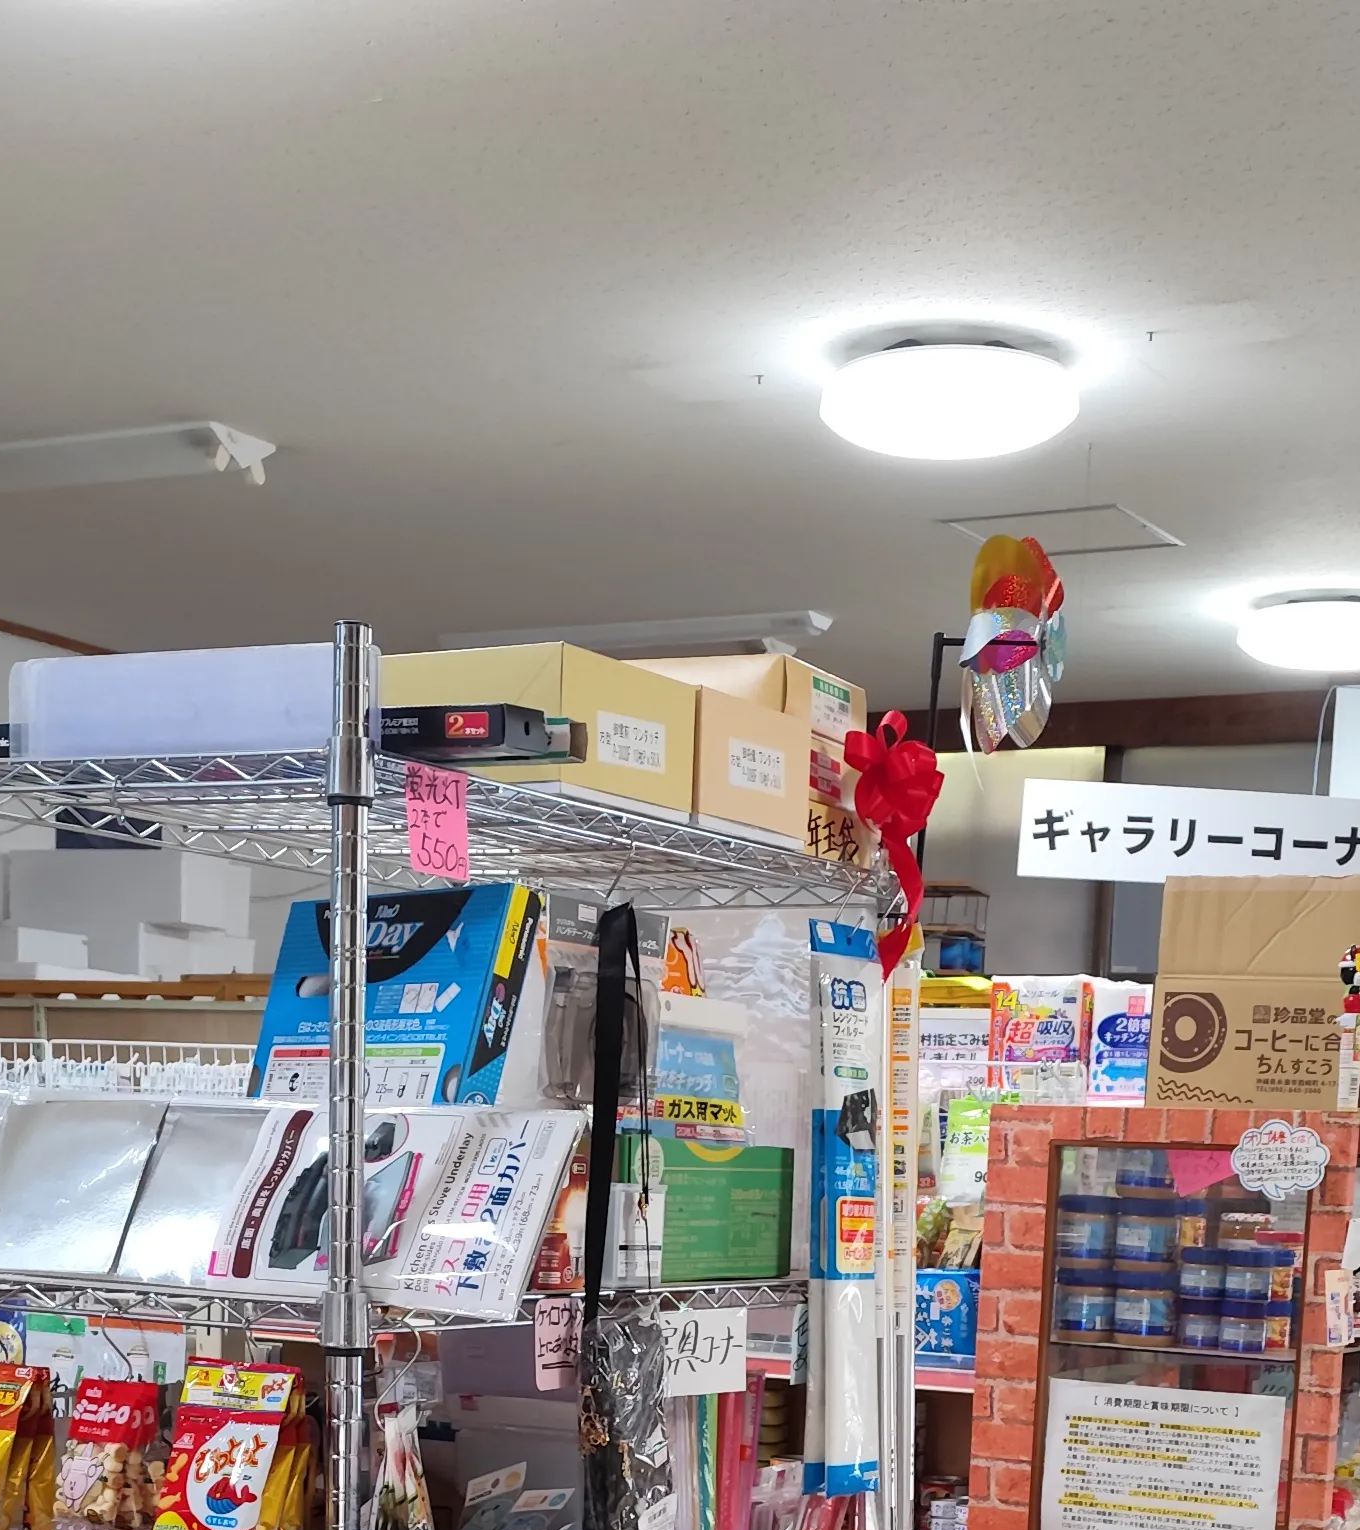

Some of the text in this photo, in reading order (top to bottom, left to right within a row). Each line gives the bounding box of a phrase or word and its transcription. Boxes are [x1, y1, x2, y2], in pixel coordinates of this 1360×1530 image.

[418, 835, 468, 874] 550円
[830, 978, 868, 1012] 抗菌
[832, 1024, 865, 1038] フィルター
[1255, 1053, 1333, 1077] ちんすこう
[668, 1099, 738, 1124] ガス用マット
[444, 1131, 474, 1186] Underlay
[72, 1397, 131, 1426] ミニボーロ
[1103, 1396, 1229, 1417] 消費期限と賞味期限について
[194, 1434, 267, 1481] おっとっと
